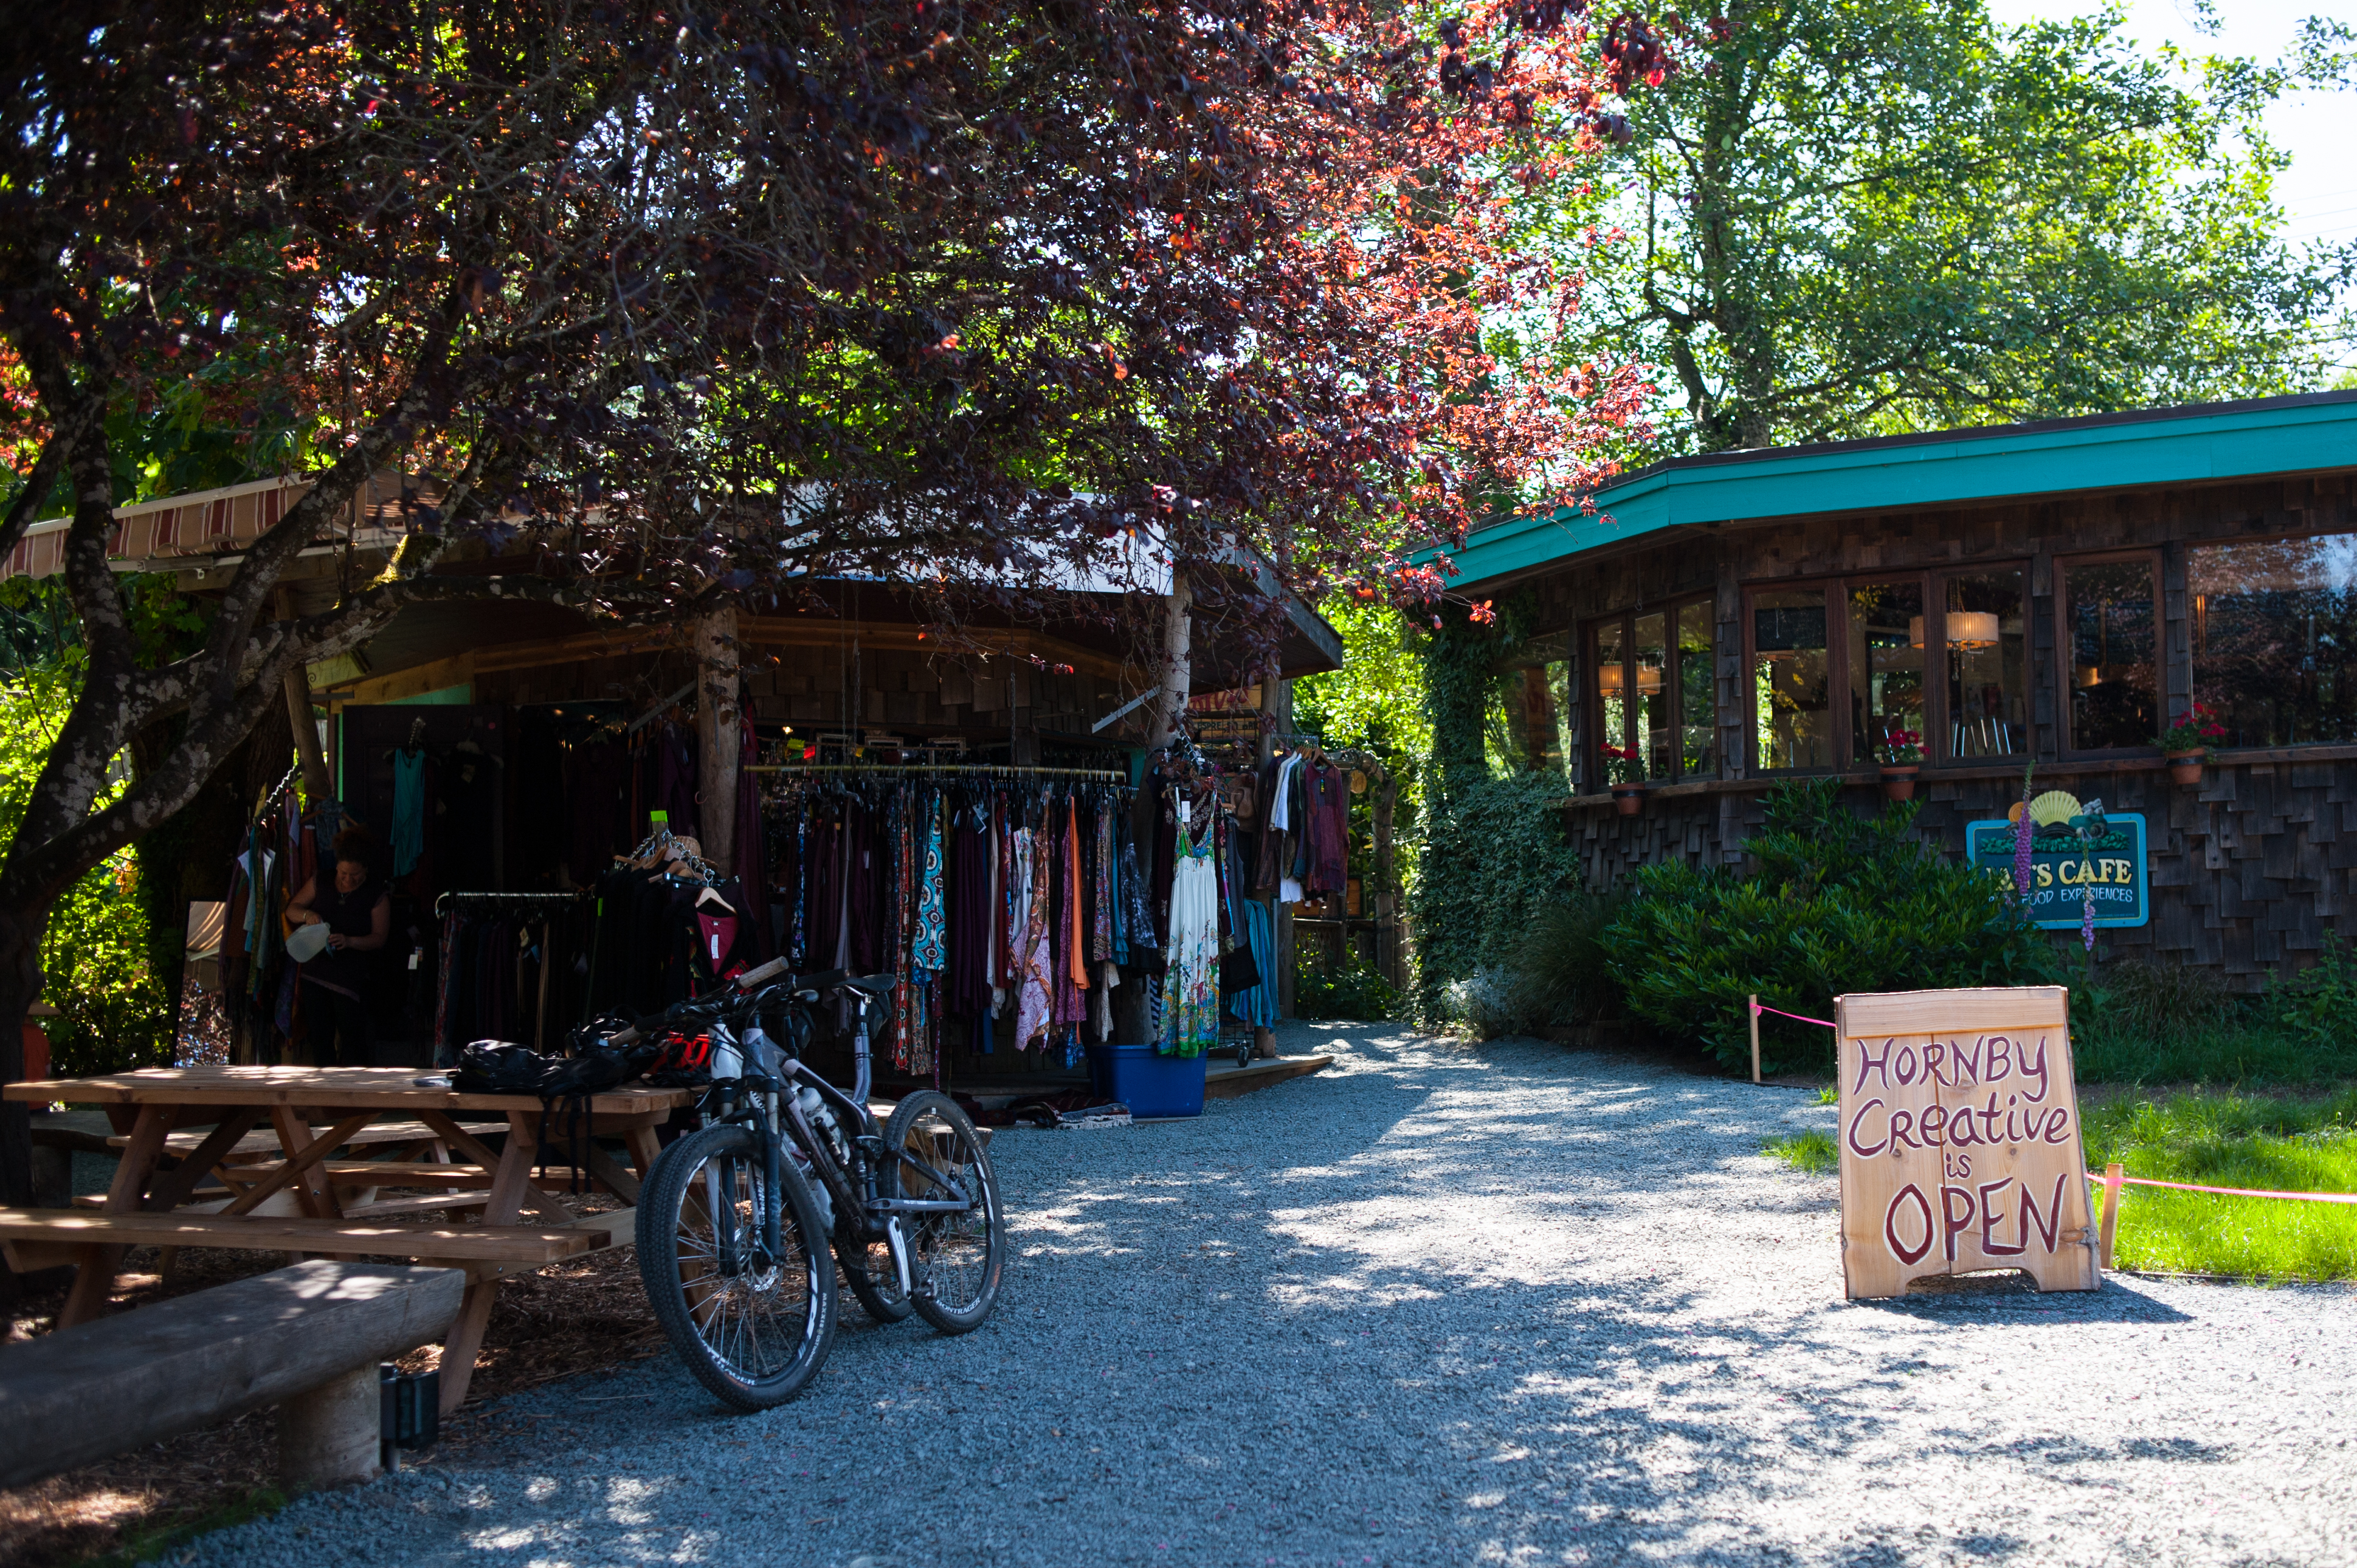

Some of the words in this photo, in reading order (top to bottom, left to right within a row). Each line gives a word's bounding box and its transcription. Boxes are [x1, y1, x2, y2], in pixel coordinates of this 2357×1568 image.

[2058, 858, 2133, 885] CAFE
[2021, 890, 2054, 906] FOOD
[1853, 1035, 2049, 1102] HORNBY
[1945, 1152, 1972, 1180] is
[1885, 1174, 2068, 1266] OPEN
